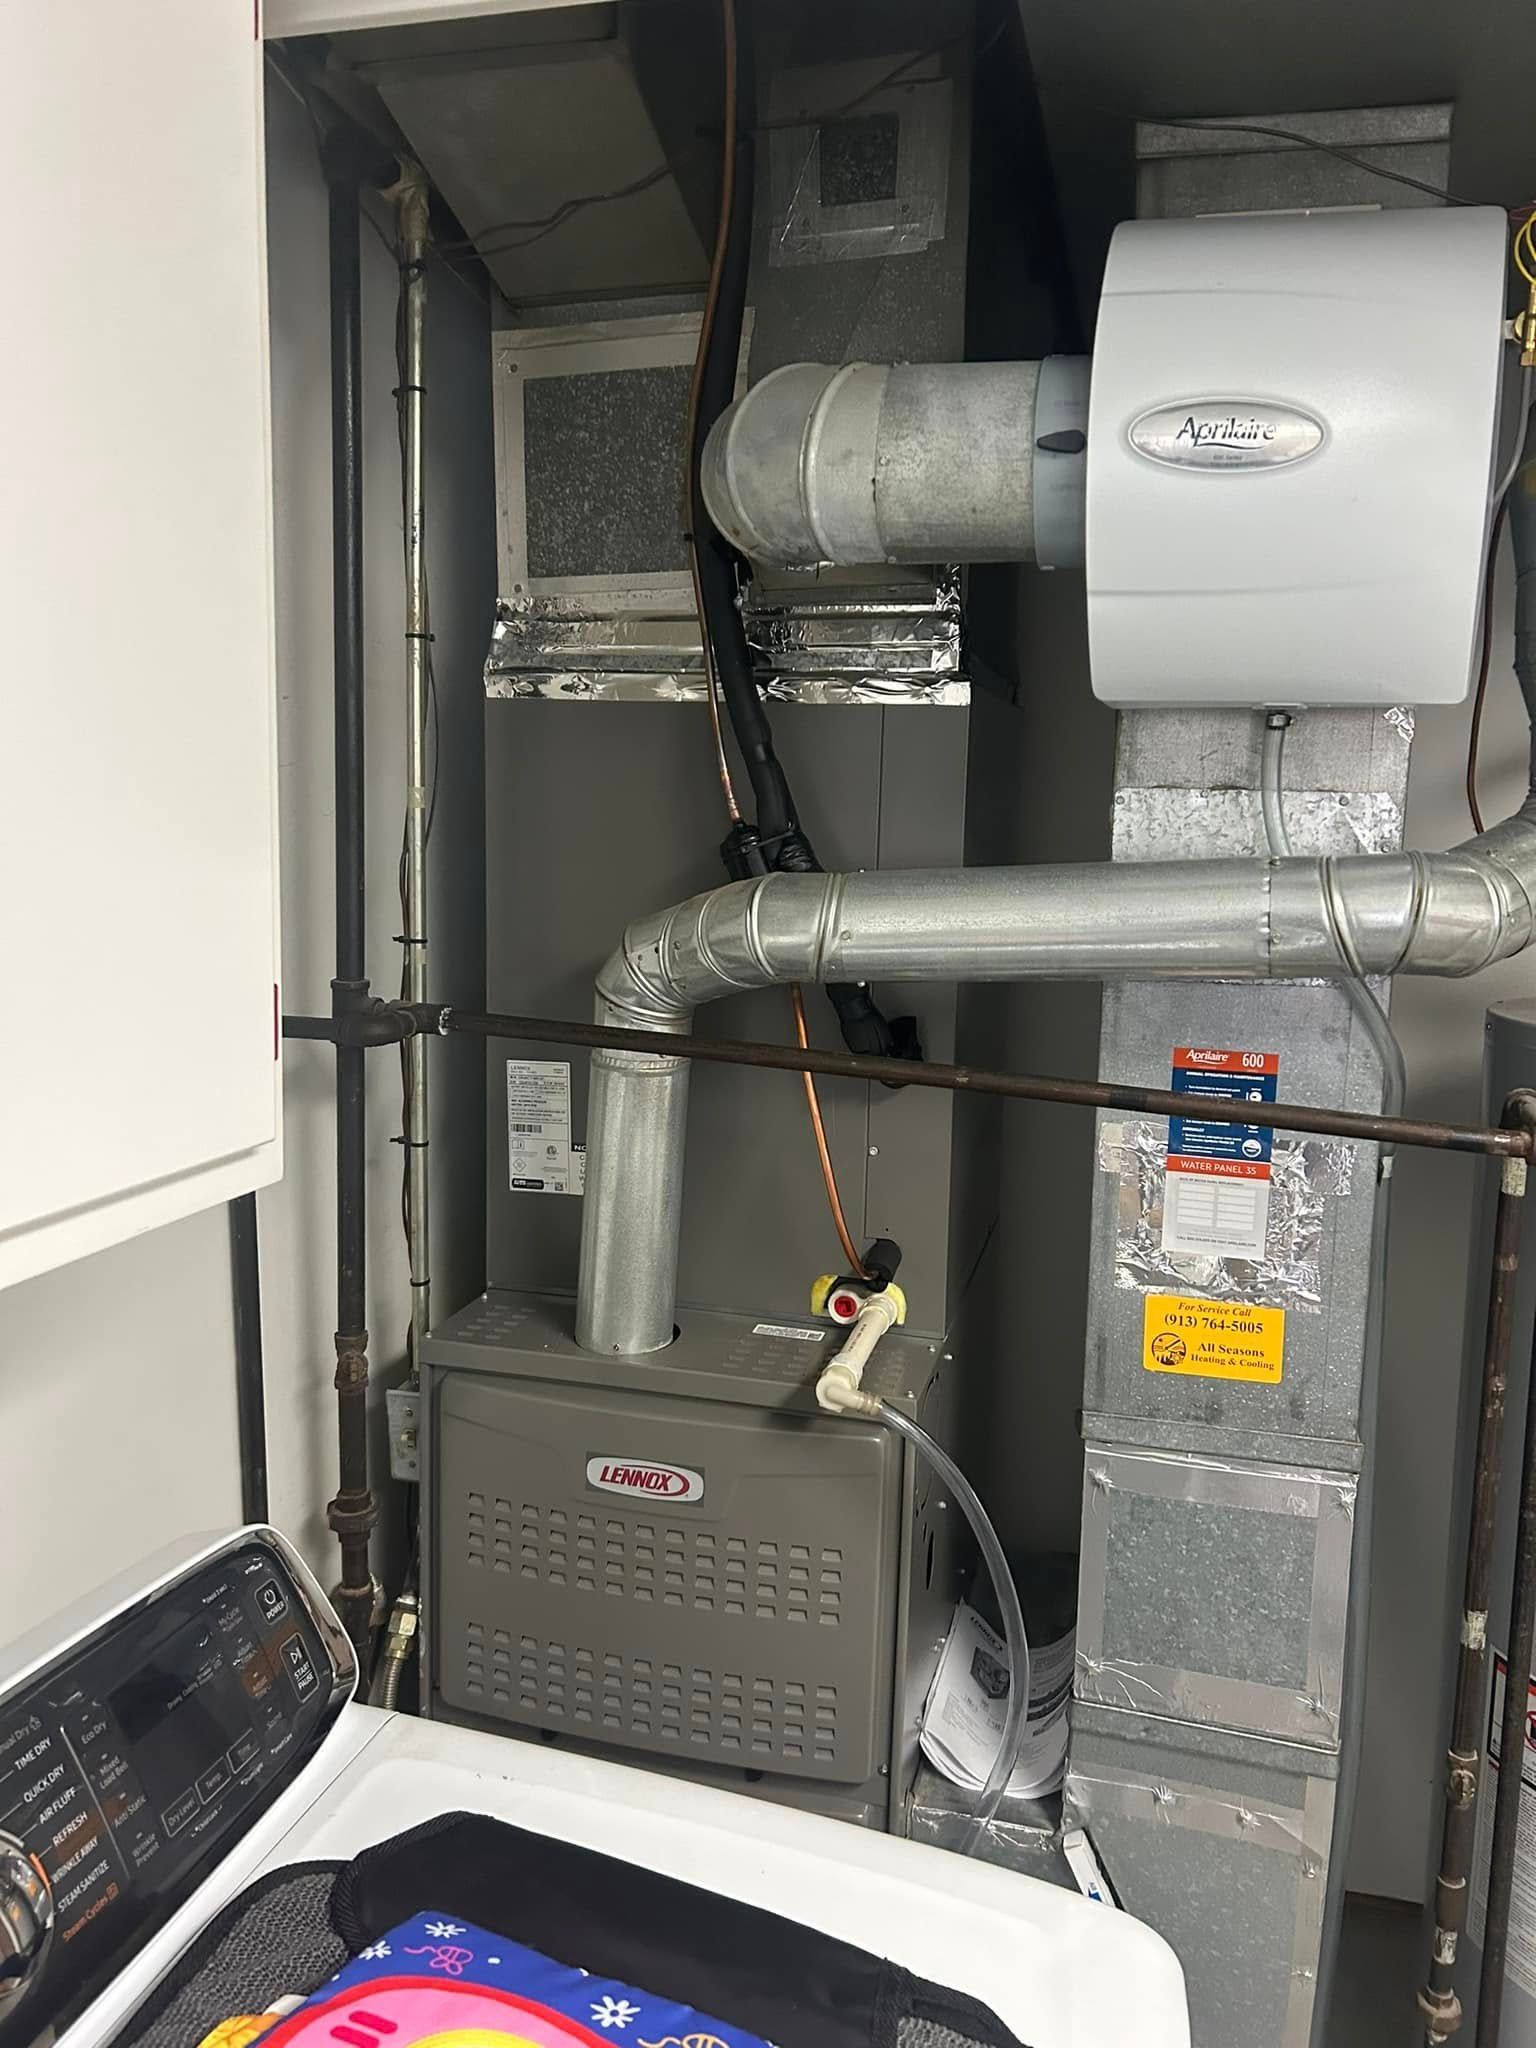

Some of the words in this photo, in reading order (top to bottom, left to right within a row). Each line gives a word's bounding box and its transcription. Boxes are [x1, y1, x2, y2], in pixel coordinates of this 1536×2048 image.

[1176, 416, 1277, 447] Aprilaire
[1186, 1049, 1229, 1063] Aprilaire
[1242, 1053, 1264, 1068] 600
[1180, 1160, 1212, 1171] WATER
[1214, 1163, 1244, 1174] PANEL
[1246, 1166, 1257, 1175] 35
[1178, 1302, 1194, 1311] For
[1197, 1304, 1230, 1315] Service
[1232, 1307, 1252, 1317] Call
[1164, 1313, 1198, 1328] (913)
[1202, 1317, 1263, 1334] 764-5005
[1198, 1343, 1215, 1353] All
[1218, 1345, 1265, 1357] Seasons
[1191, 1354, 1226, 1366] Heating
[1228, 1357, 1238, 1366] &
[1240, 1359, 1275, 1371] Cooling
[600, 1465, 673, 1491] LENNOX
[266, 1600, 285, 1619] POWER
[294, 1661, 311, 1680] START
[297, 1673, 315, 1690] PAUSE
[14, 1726, 30, 1741] Dry
[81, 1730, 96, 1744] Eco
[94, 1721, 107, 1736] Dry
[14, 1750, 37, 1770] TIME
[33, 1737, 52, 1756] DRY
[23, 1780, 49, 1803] QUICK
[47, 1763, 65, 1783] DRY
[39, 1808, 54, 1825] AIR
[52, 1786, 77, 1813] FLUFF
[52, 1811, 88, 1847] REFRESH
[51, 1851, 82, 1884] WRINKLE
[79, 1835, 98, 1859] AWAY
[57, 1885, 82, 1913] STEAM
[79, 1859, 110, 1892] SANITIZE
[85, 1896, 109, 1919] Cycles
